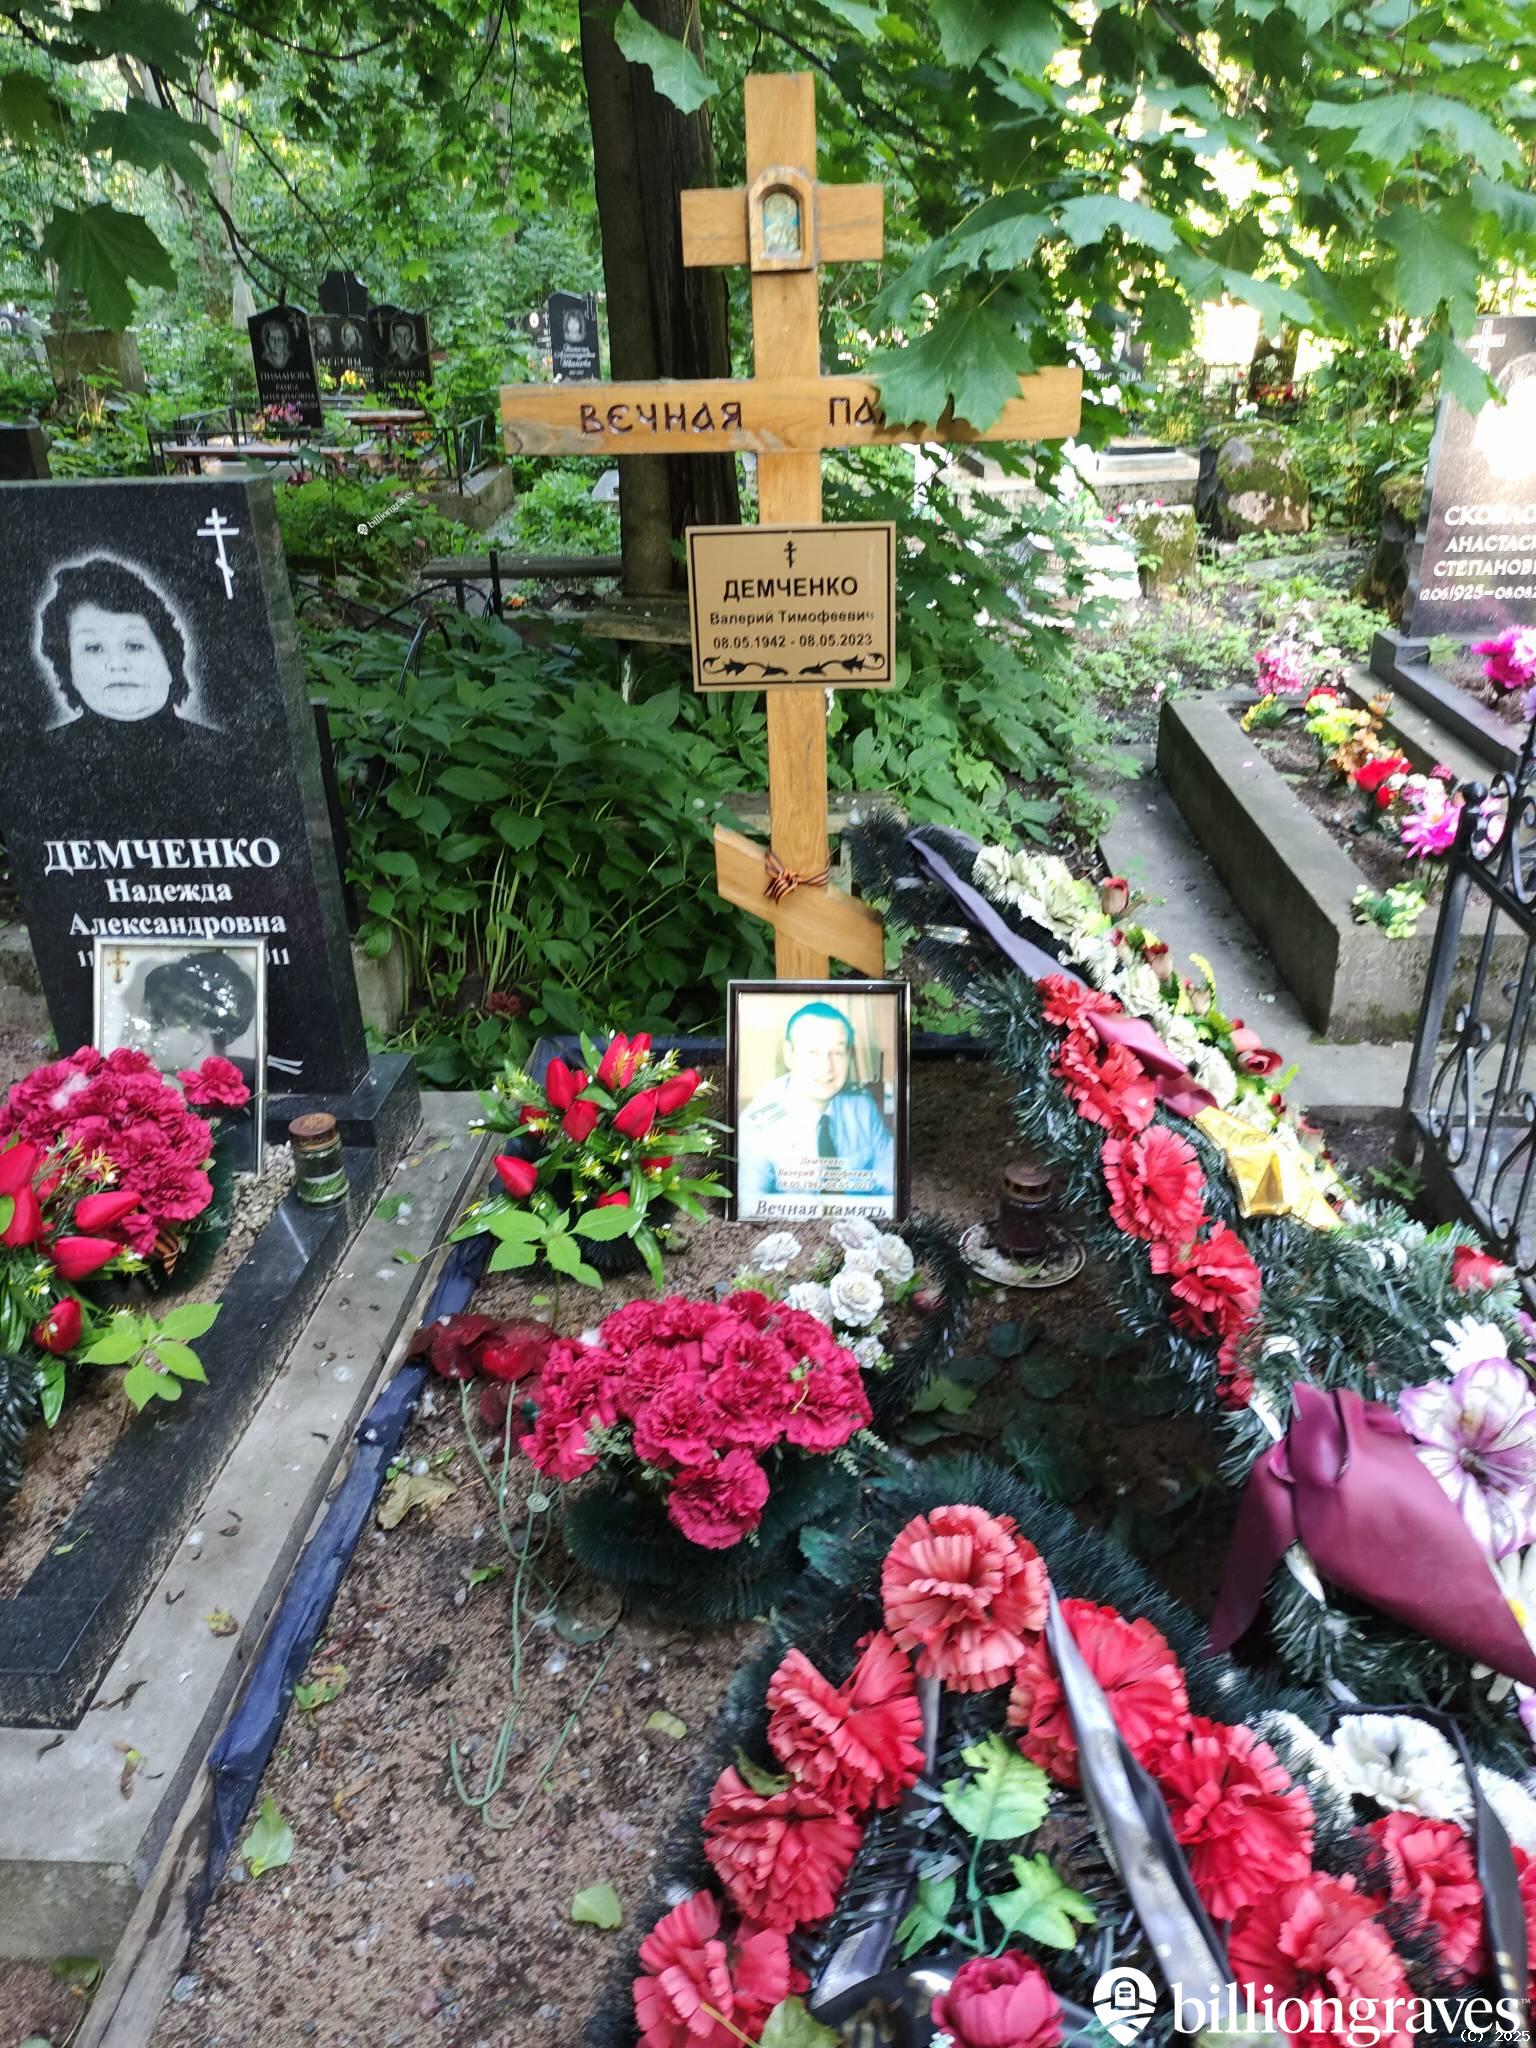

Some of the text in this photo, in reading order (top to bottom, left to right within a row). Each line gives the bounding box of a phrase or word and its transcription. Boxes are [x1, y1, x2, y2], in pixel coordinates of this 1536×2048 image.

[828, 397, 886, 429] ПА
[1433, 559, 1536, 577] СТЕПАНОВ
[723, 576, 858, 602] ДЕМЧЕНКО
[710, 609, 875, 627] Валерий Тимофеевич
[713, 635, 786, 649] 08.05.1942
[799, 632, 873, 648] 08.05.2023
[43, 837, 281, 877] ДЕМЧЕНКО
[105, 878, 233, 904] Надежда
[69, 912, 287, 940] Александровна
[756, 1200, 887, 1217] Вечная память
